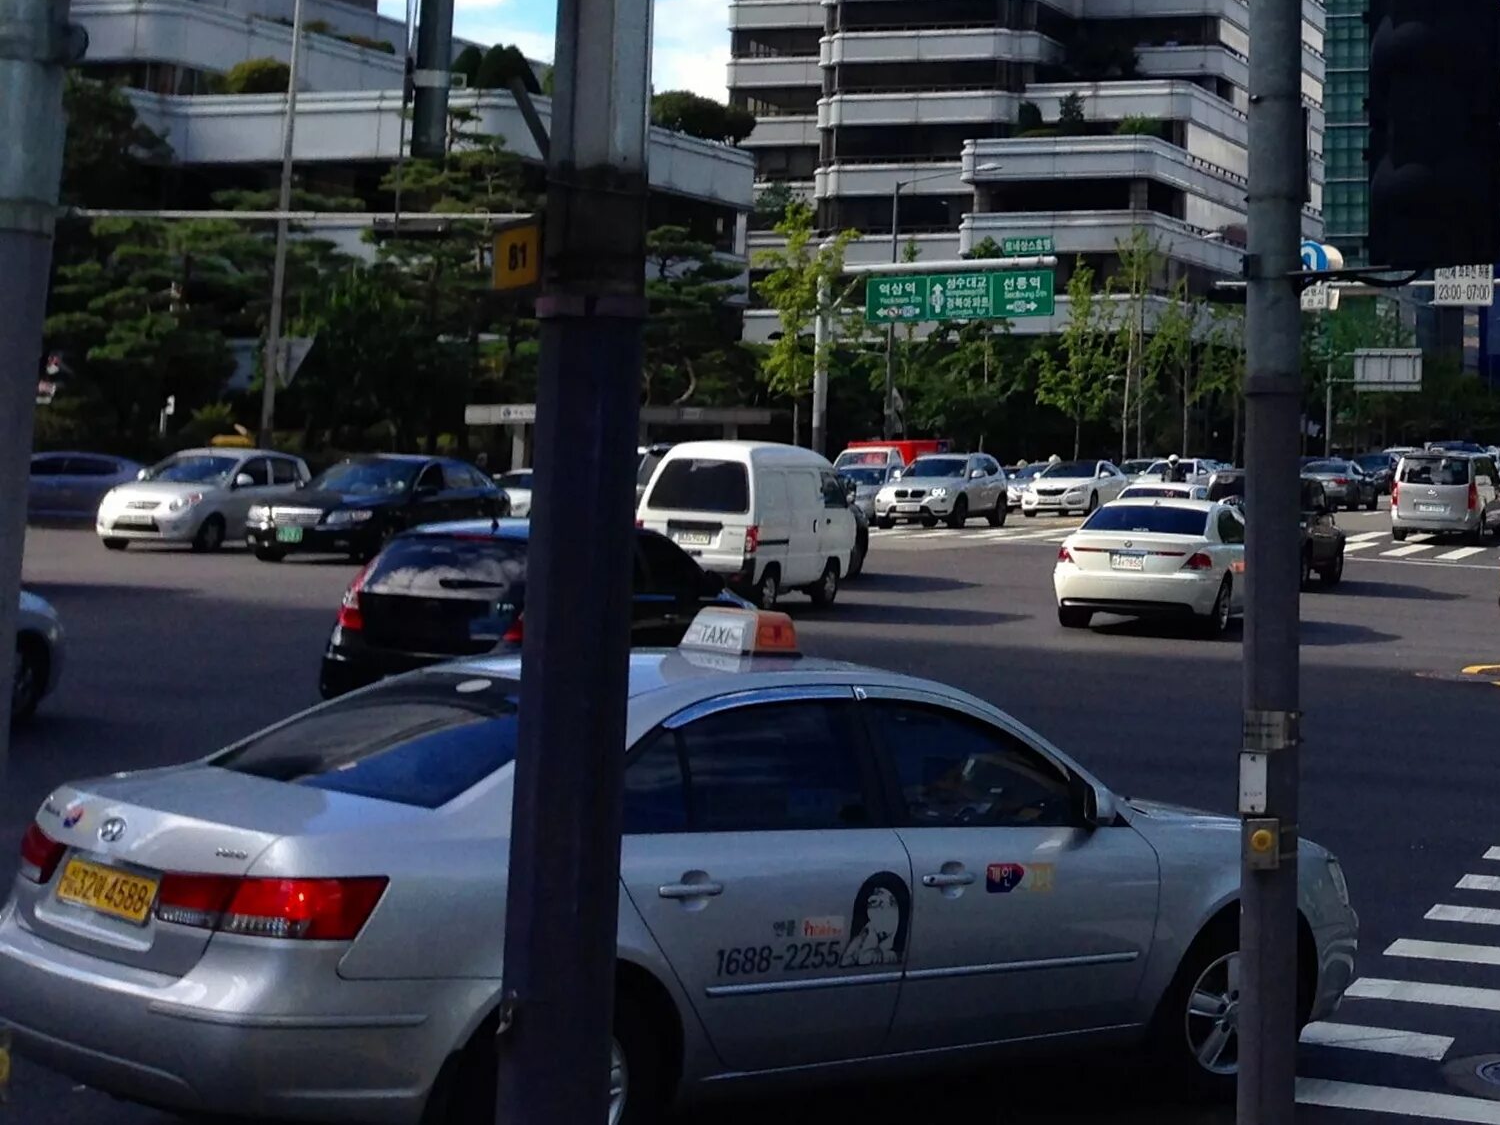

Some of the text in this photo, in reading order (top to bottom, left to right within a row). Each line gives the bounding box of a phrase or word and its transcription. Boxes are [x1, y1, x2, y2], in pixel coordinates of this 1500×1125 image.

[946, 277, 987, 290] 성수대교
[1003, 276, 1041, 291] 선릉역
[1438, 284, 1490, 300] 23:00-07:00
[701, 624, 733, 645] TAXI
[716, 940, 841, 977] 1688-2255
